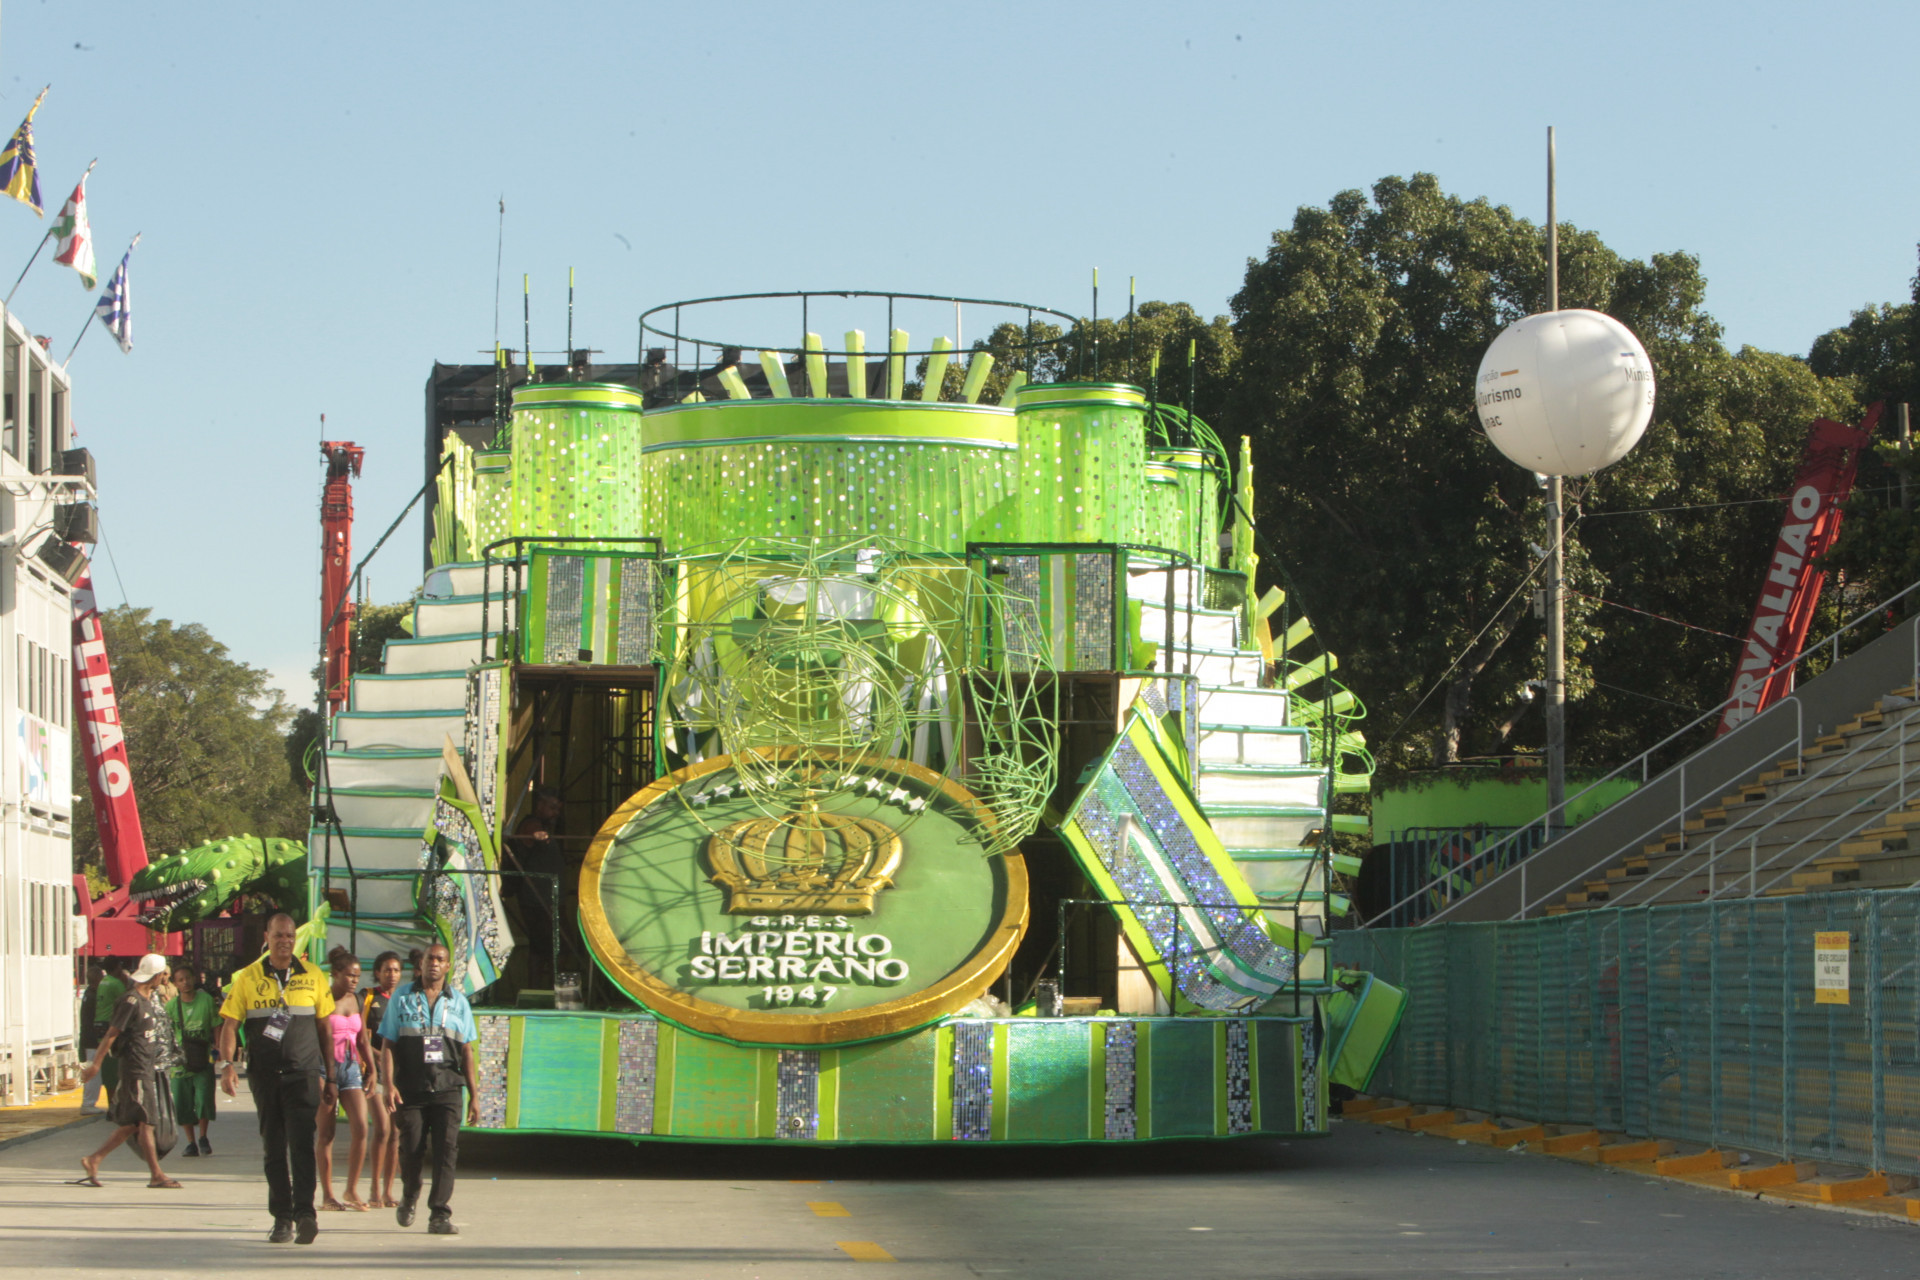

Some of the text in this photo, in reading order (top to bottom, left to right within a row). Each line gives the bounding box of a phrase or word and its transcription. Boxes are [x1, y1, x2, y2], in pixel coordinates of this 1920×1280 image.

[1718, 485, 1820, 737] ARVALHÃO
[751, 915, 854, 927] G.R.E.S.
[701, 926, 892, 957] IMPÉRIO
[690, 955, 909, 980] SERRANO
[762, 985, 838, 1001] 1947
[398, 1013, 419, 1022] 176
